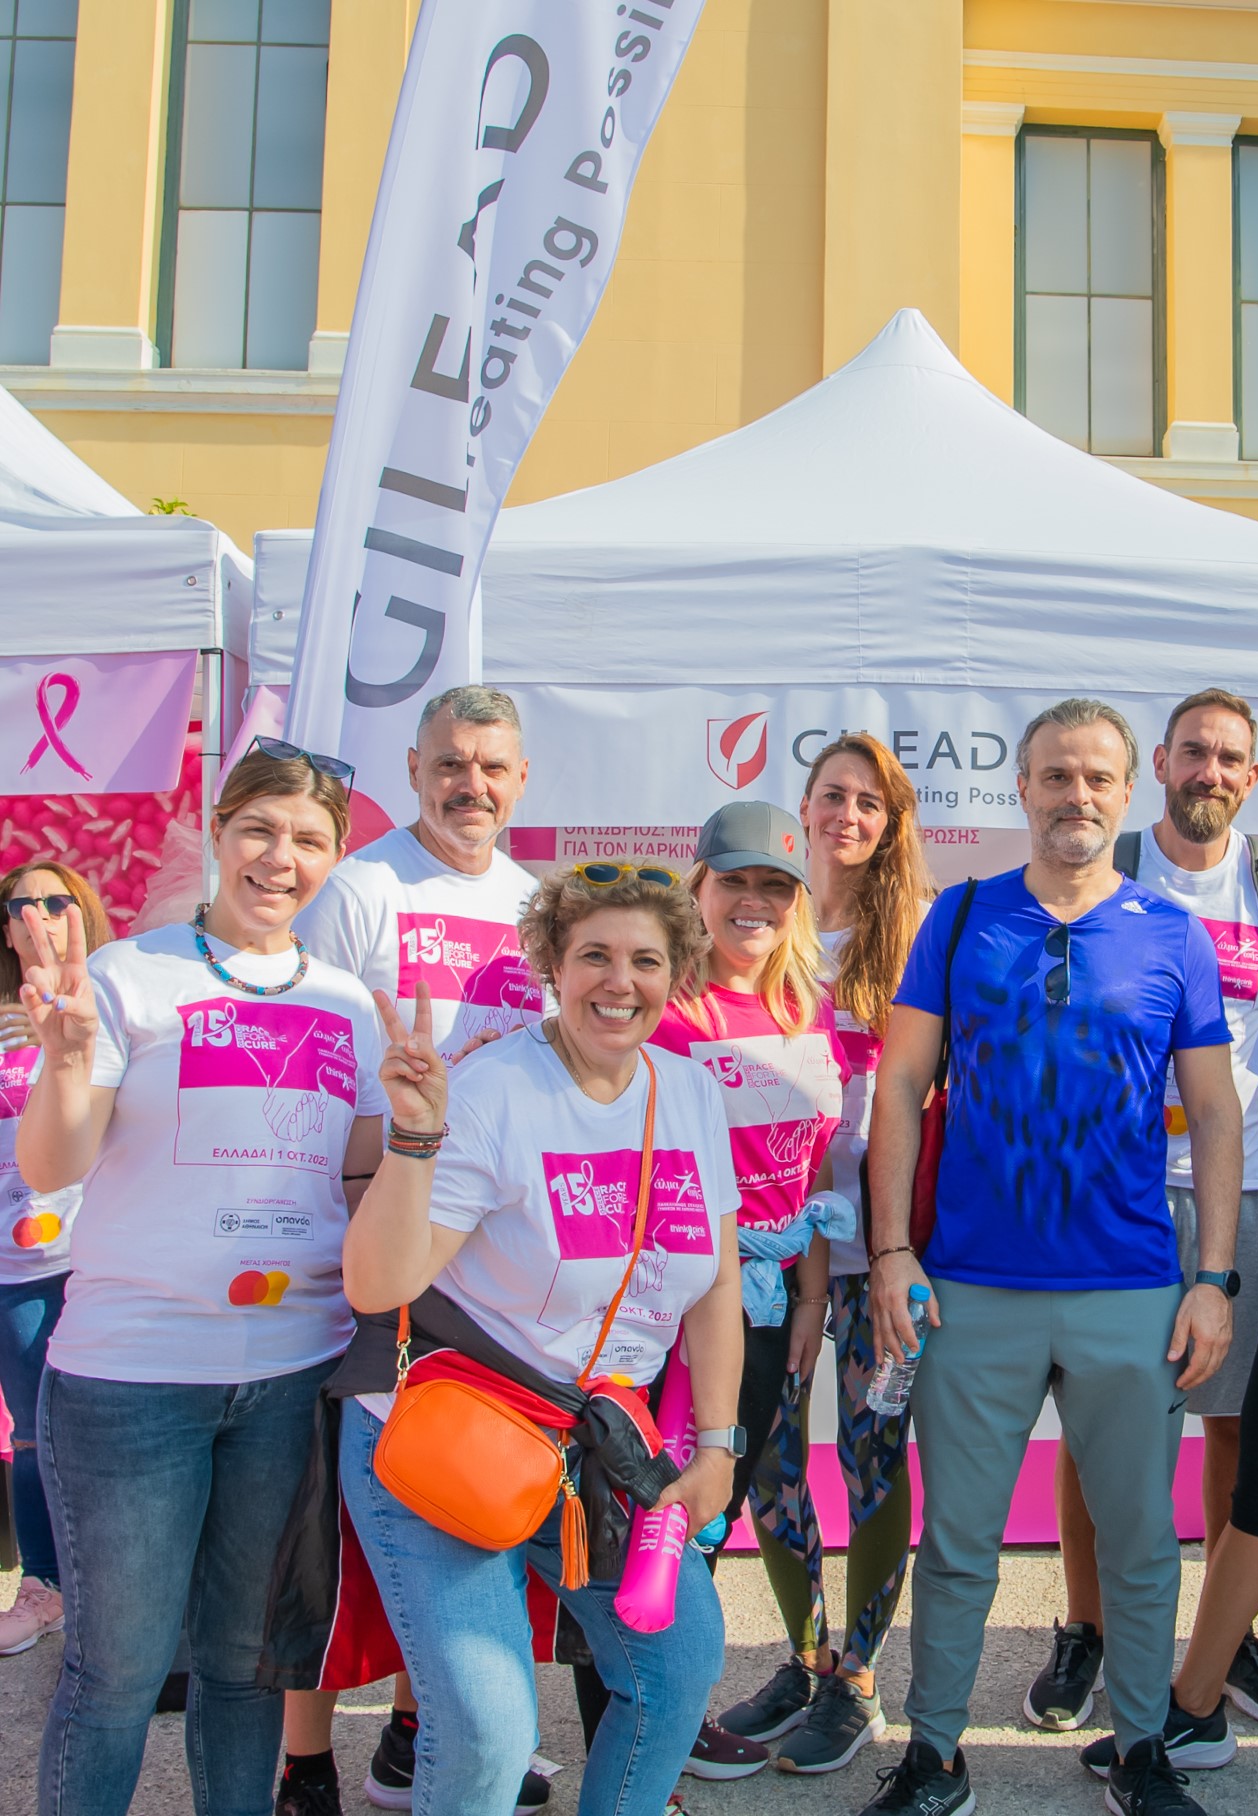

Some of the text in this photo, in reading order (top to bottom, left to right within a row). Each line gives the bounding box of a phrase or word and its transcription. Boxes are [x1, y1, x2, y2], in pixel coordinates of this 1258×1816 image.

[563, 0, 676, 194] Possi
[792, 729, 1008, 771] GEAD
[916, 786, 1019, 808] ting Poss
[671, 827, 698, 838] ΜΗ
[922, 829, 980, 844] ΡΩΣΗΣ
[564, 841, 698, 859] ΓΙΑ ΤΟΝ ΚΑΡΚΙΝ
[402, 928, 442, 964] 15
[448, 940, 472, 952] RACE
[449, 949, 465, 959] FOR
[187, 1008, 233, 1047] 15
[748, 1062, 775, 1071] RACE
[751, 1070, 772, 1080] FOR
[213, 1148, 267, 1159] ΕΛΛΑΔΑ
[277, 1150, 283, 1159] 1
[550, 1172, 594, 1216] 15
[648, 1310, 673, 1321] 2023
